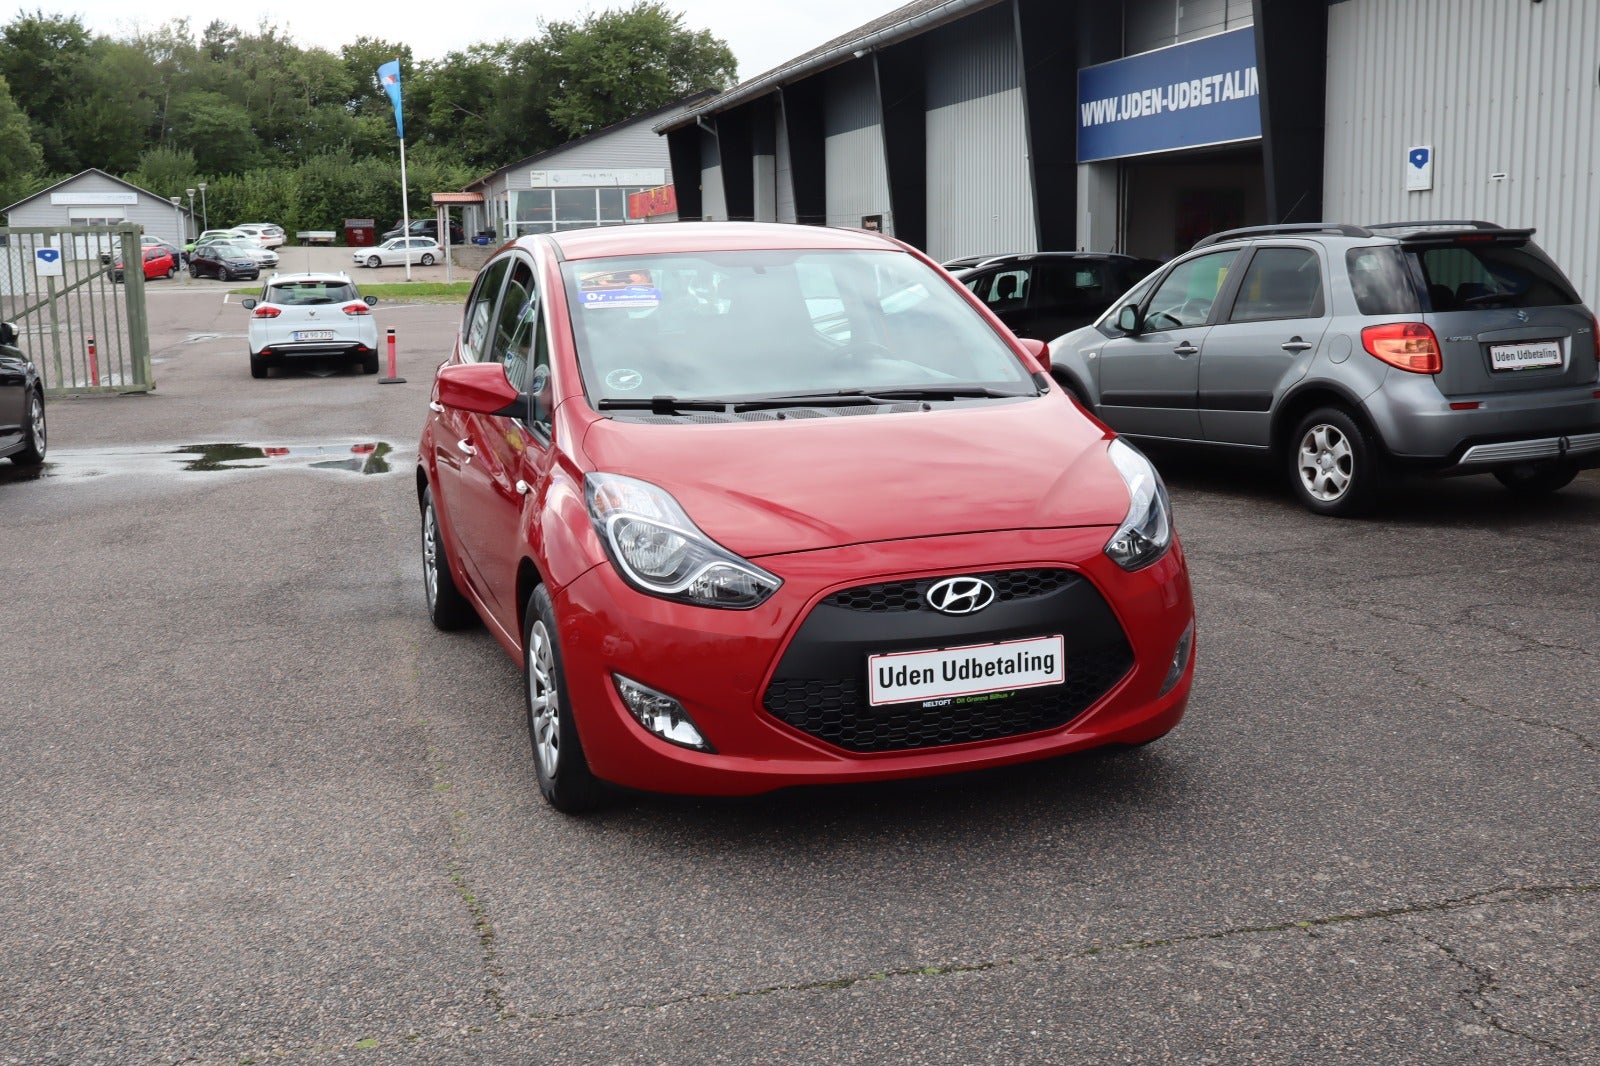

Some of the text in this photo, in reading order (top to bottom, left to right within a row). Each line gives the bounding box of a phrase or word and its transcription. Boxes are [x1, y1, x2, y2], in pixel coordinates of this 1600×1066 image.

[1494, 348, 1558, 362] Uden Udbetaling
[879, 651, 1054, 688] Uden Udbetaling
[922, 698, 952, 708] NELTOFT
